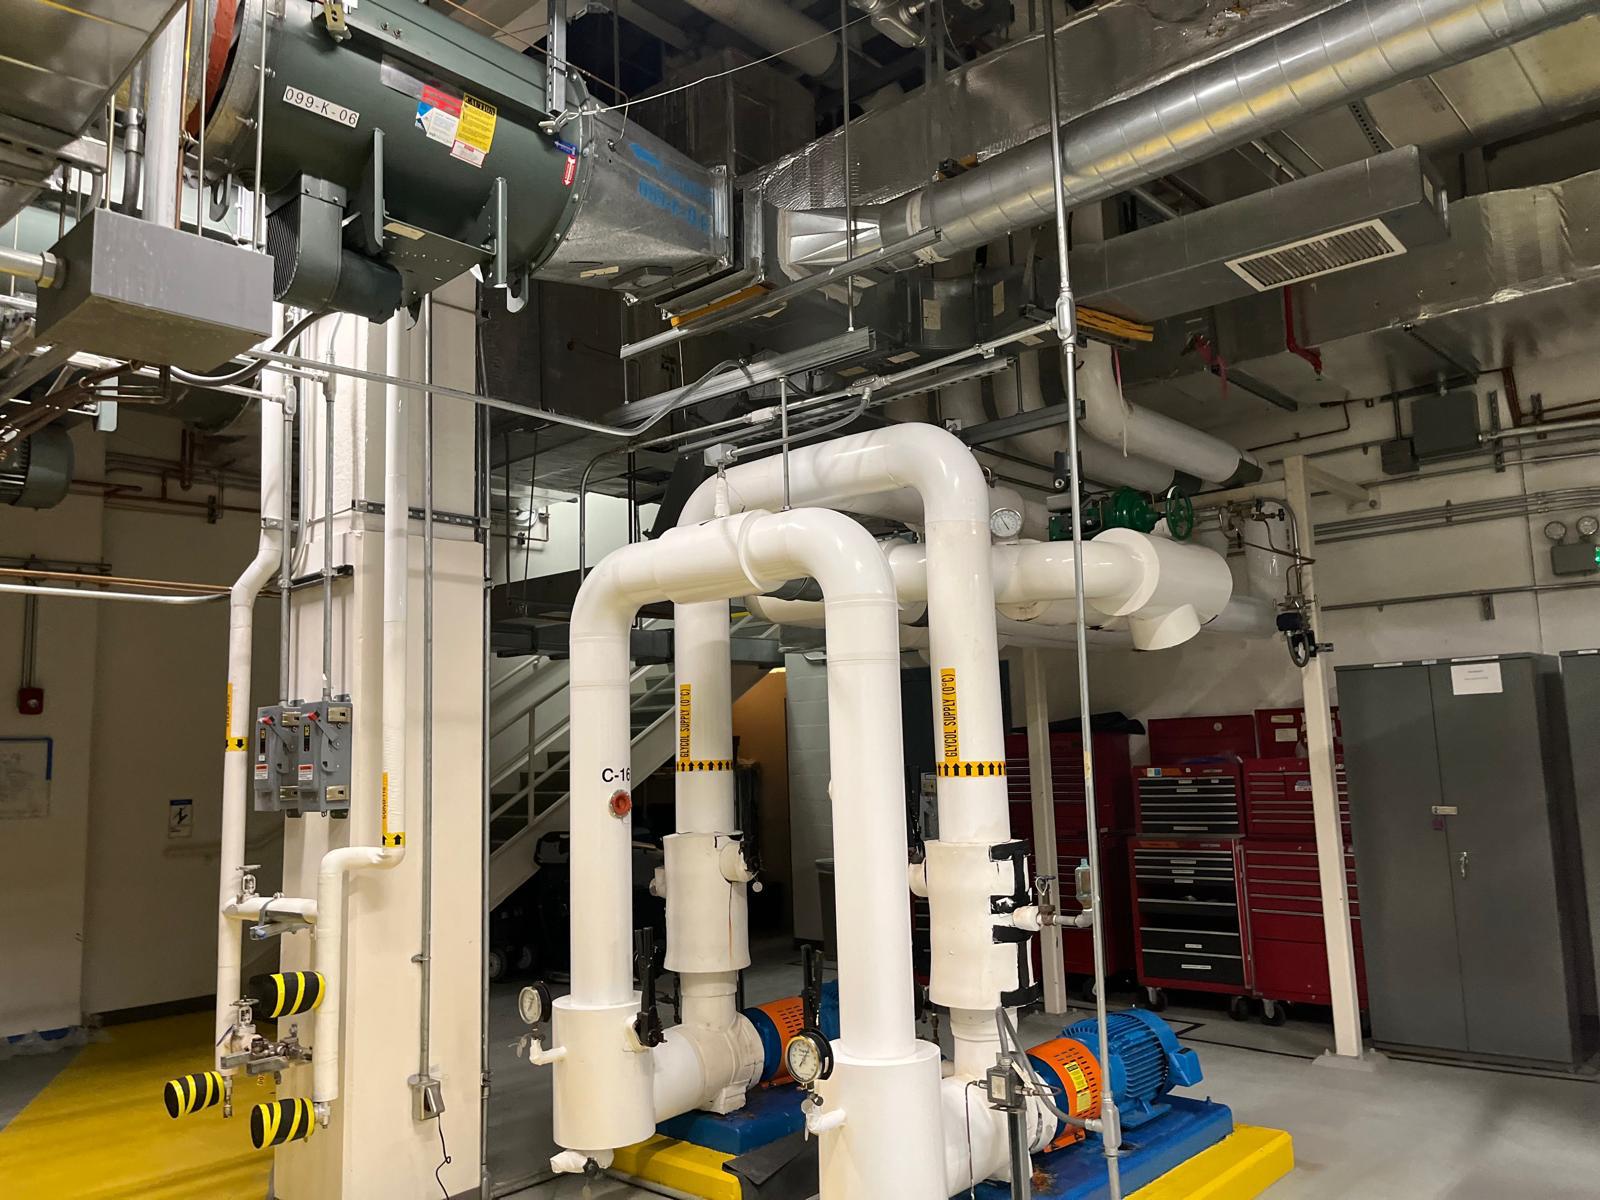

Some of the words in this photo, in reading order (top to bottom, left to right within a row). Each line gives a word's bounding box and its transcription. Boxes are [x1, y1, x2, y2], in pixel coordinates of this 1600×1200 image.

[285, 88, 358, 125] 099-K-06
[465, 96, 496, 116] CAUTION
[680, 709, 690, 732] SUPPLY
[943, 699, 957, 726] SUPPLY
[680, 735, 690, 758] GLYCOL
[944, 729, 958, 757] GLYCOL
